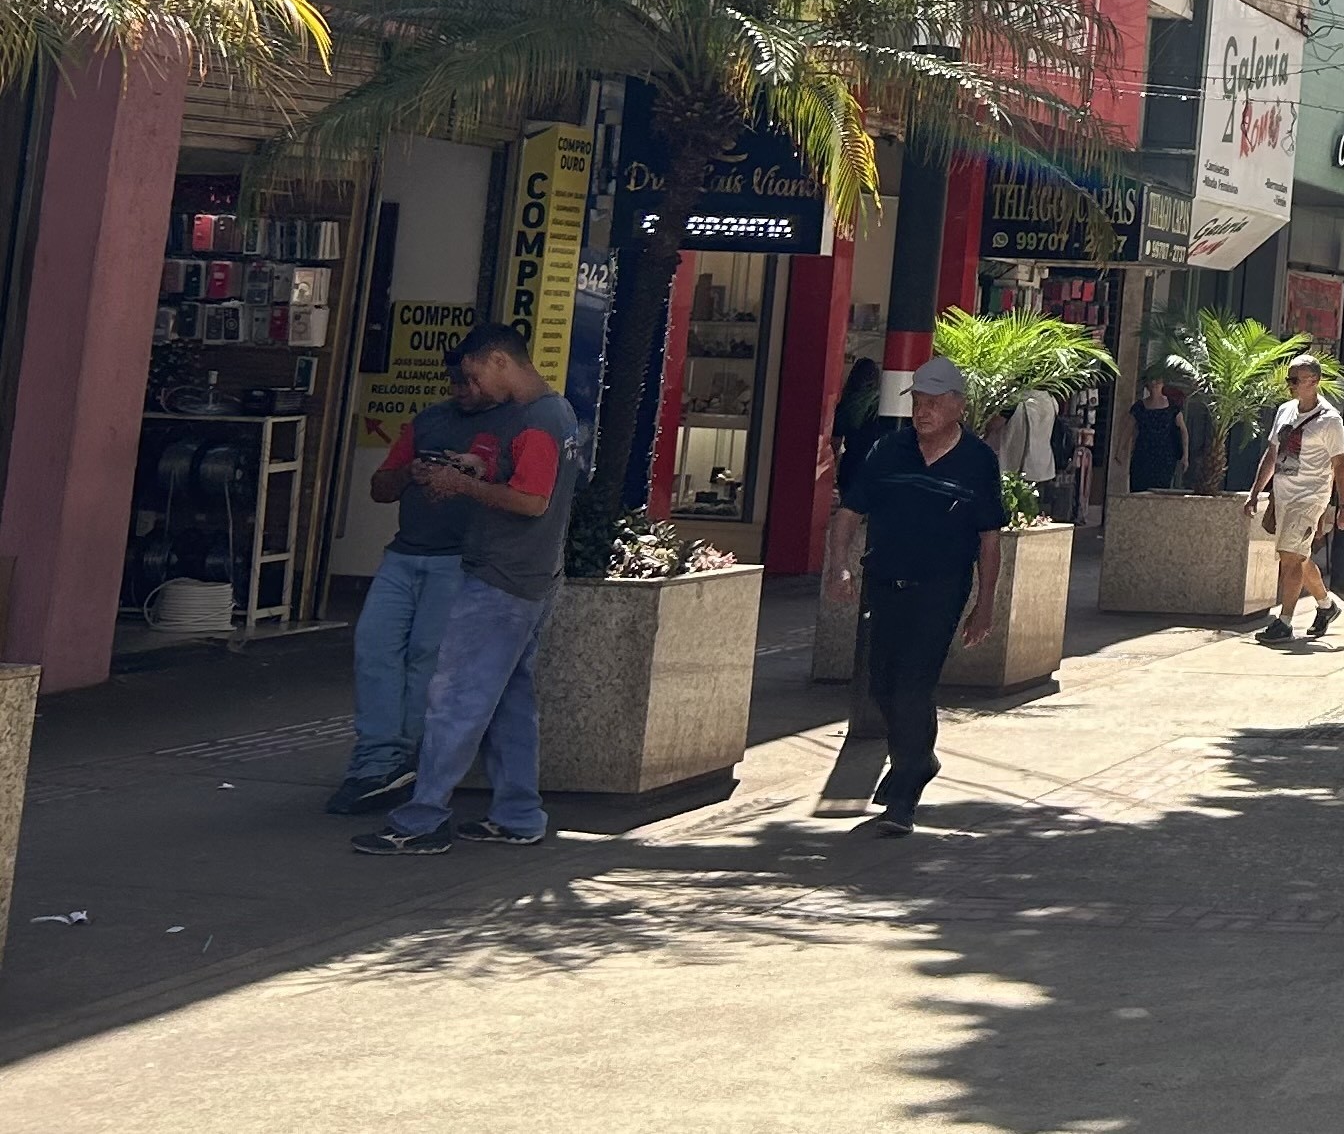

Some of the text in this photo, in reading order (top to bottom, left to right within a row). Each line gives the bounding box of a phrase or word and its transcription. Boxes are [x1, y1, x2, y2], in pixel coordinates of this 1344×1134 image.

[1222, 35, 1289, 98] Galeria
[560, 154, 586, 172] OURO
[577, 262, 609, 291] 342
[400, 305, 476, 327] COMPRO
[367, 401, 405, 414] PAGO
